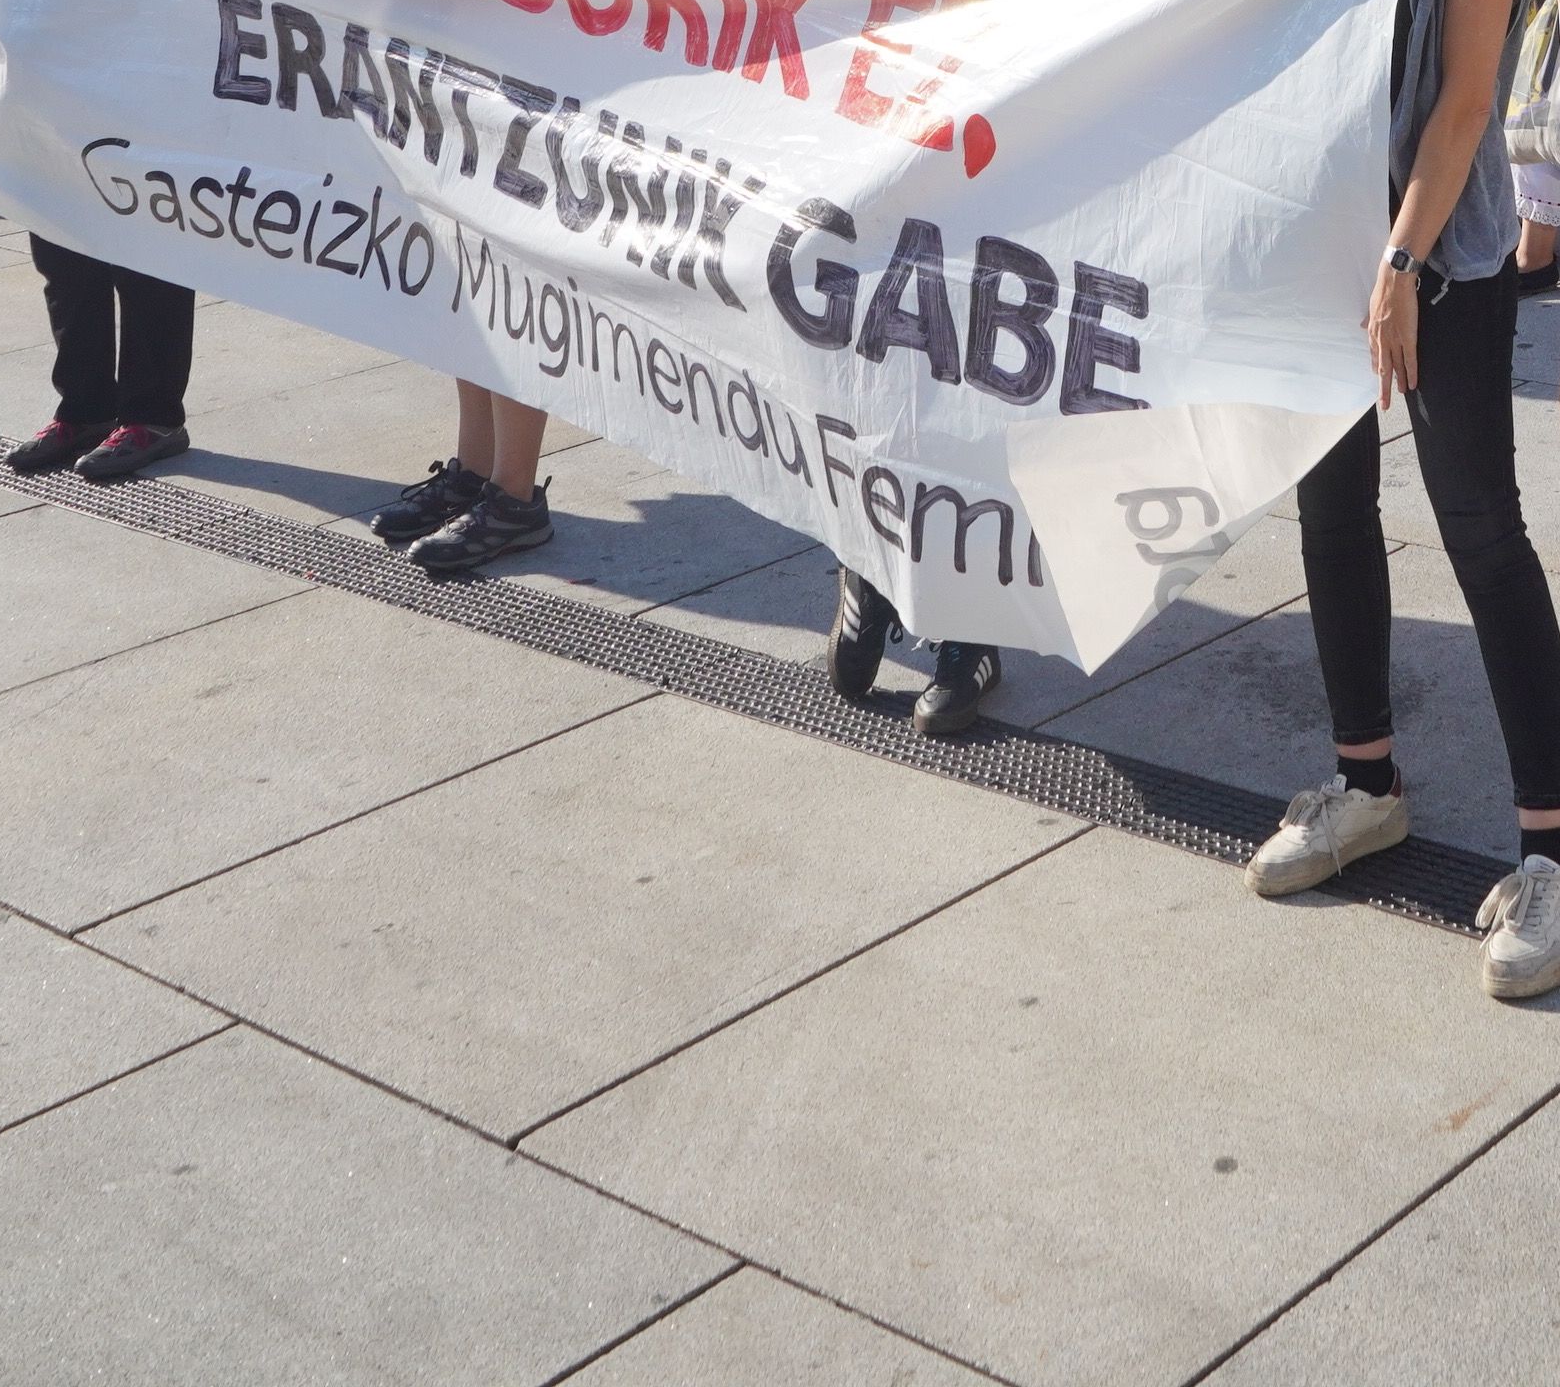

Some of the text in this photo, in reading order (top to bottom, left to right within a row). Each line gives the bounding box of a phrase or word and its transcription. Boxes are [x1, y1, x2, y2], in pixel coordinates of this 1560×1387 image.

[80, 137, 435, 297] Gasteizko
[451, 221, 814, 488] Mugimendu
[766, 196, 1151, 417] GABE
